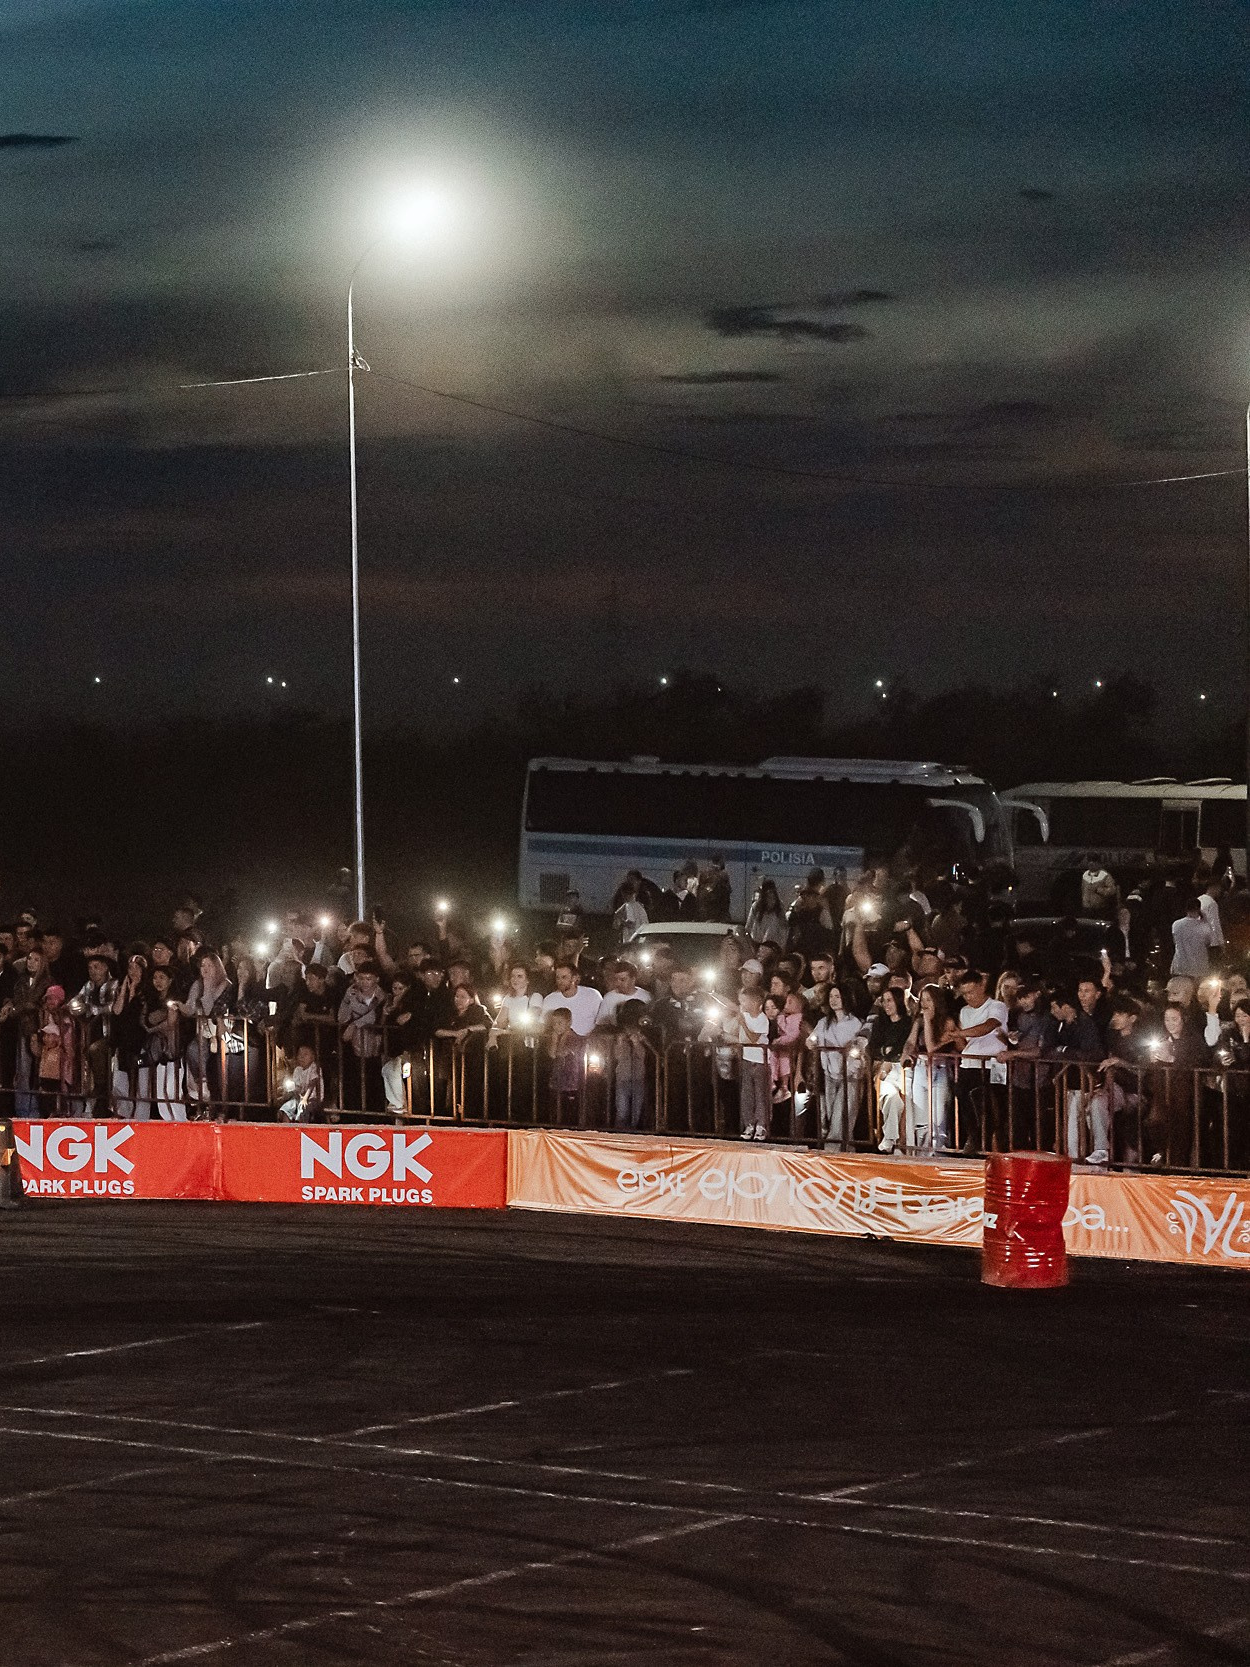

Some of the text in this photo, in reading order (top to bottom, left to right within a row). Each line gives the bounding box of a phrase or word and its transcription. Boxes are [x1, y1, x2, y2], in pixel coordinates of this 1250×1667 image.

[761, 850, 815, 865] POLISIA
[14, 1124, 136, 1175] NGK
[301, 1131, 434, 1184] NGK
[70, 1179, 136, 1195] PLUGS
[301, 1185, 434, 1204] SPARK PLUGS
